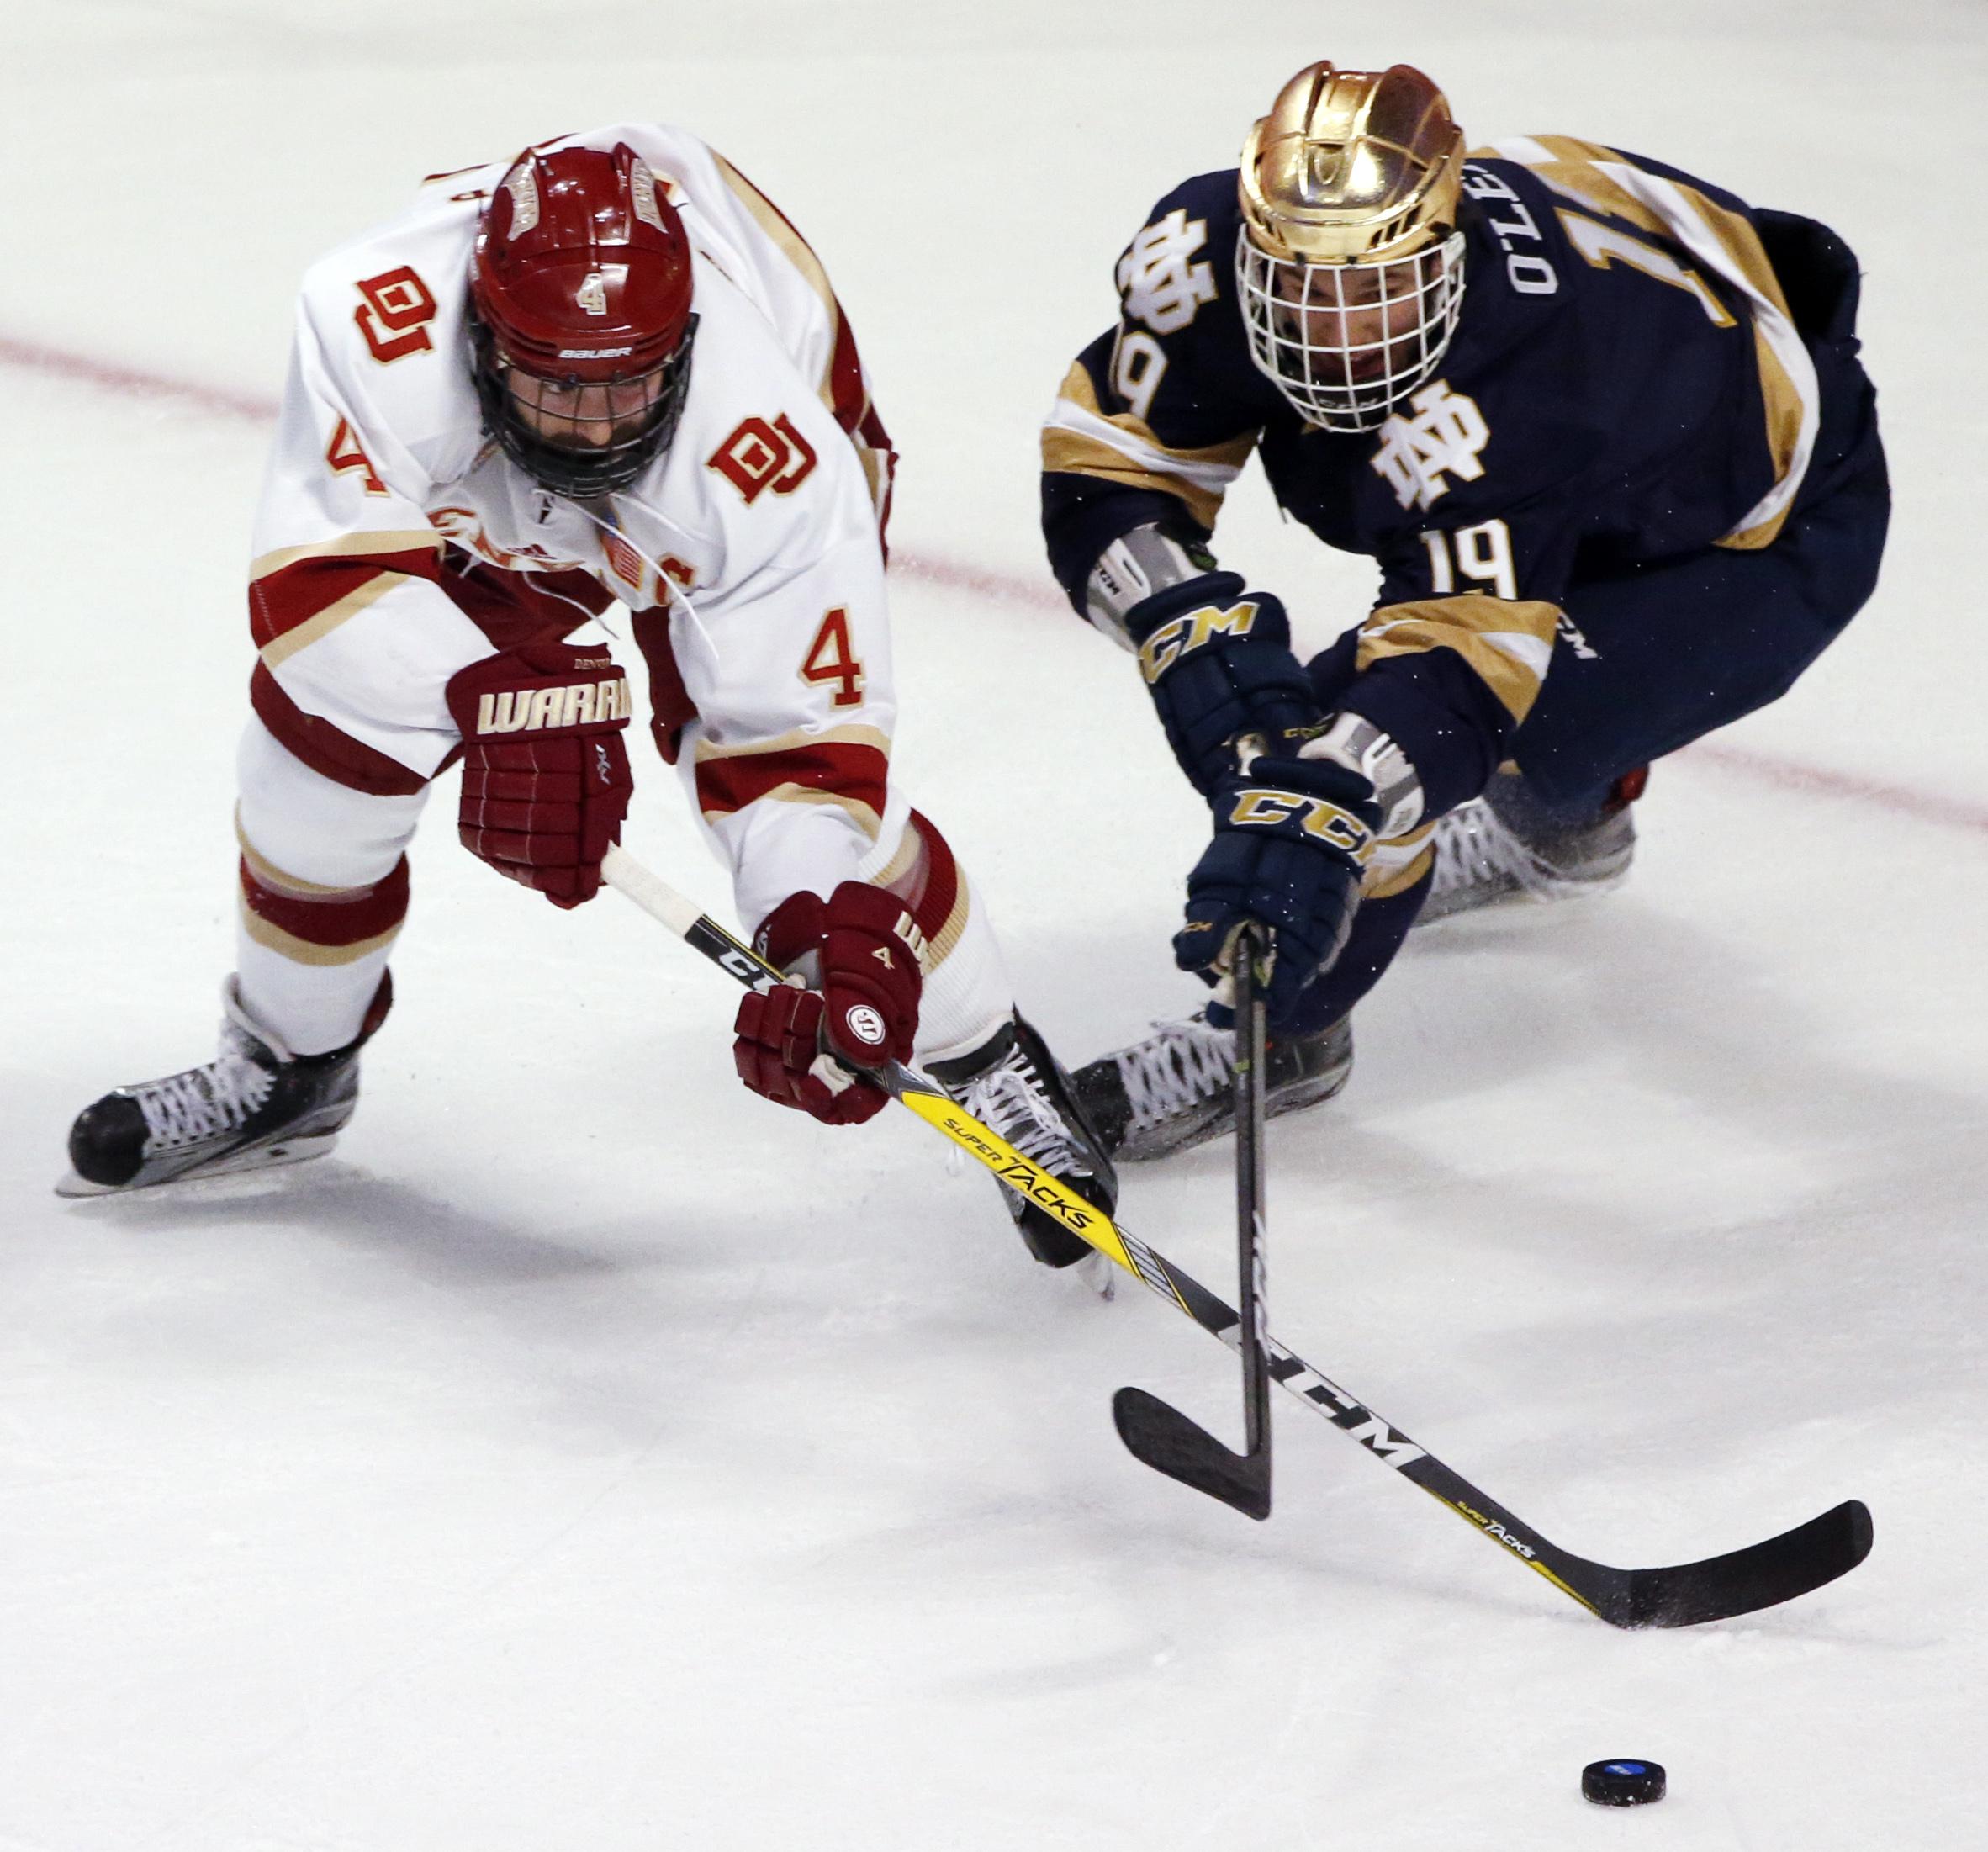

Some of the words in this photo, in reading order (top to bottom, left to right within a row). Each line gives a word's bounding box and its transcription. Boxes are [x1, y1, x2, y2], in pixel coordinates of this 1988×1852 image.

[574, 273, 607, 315] 4
[558, 346, 632, 360] BAUER
[1109, 330, 1169, 421] 9
[325, 416, 390, 498] 4
[703, 411, 818, 508] DU
[1418, 519, 1518, 601] 19
[797, 603, 866, 713] 4
[943, 1116, 1003, 1163] SUPER
[996, 1156, 1095, 1230] TACKS
[1483, 1519, 1536, 1558] TACKS
